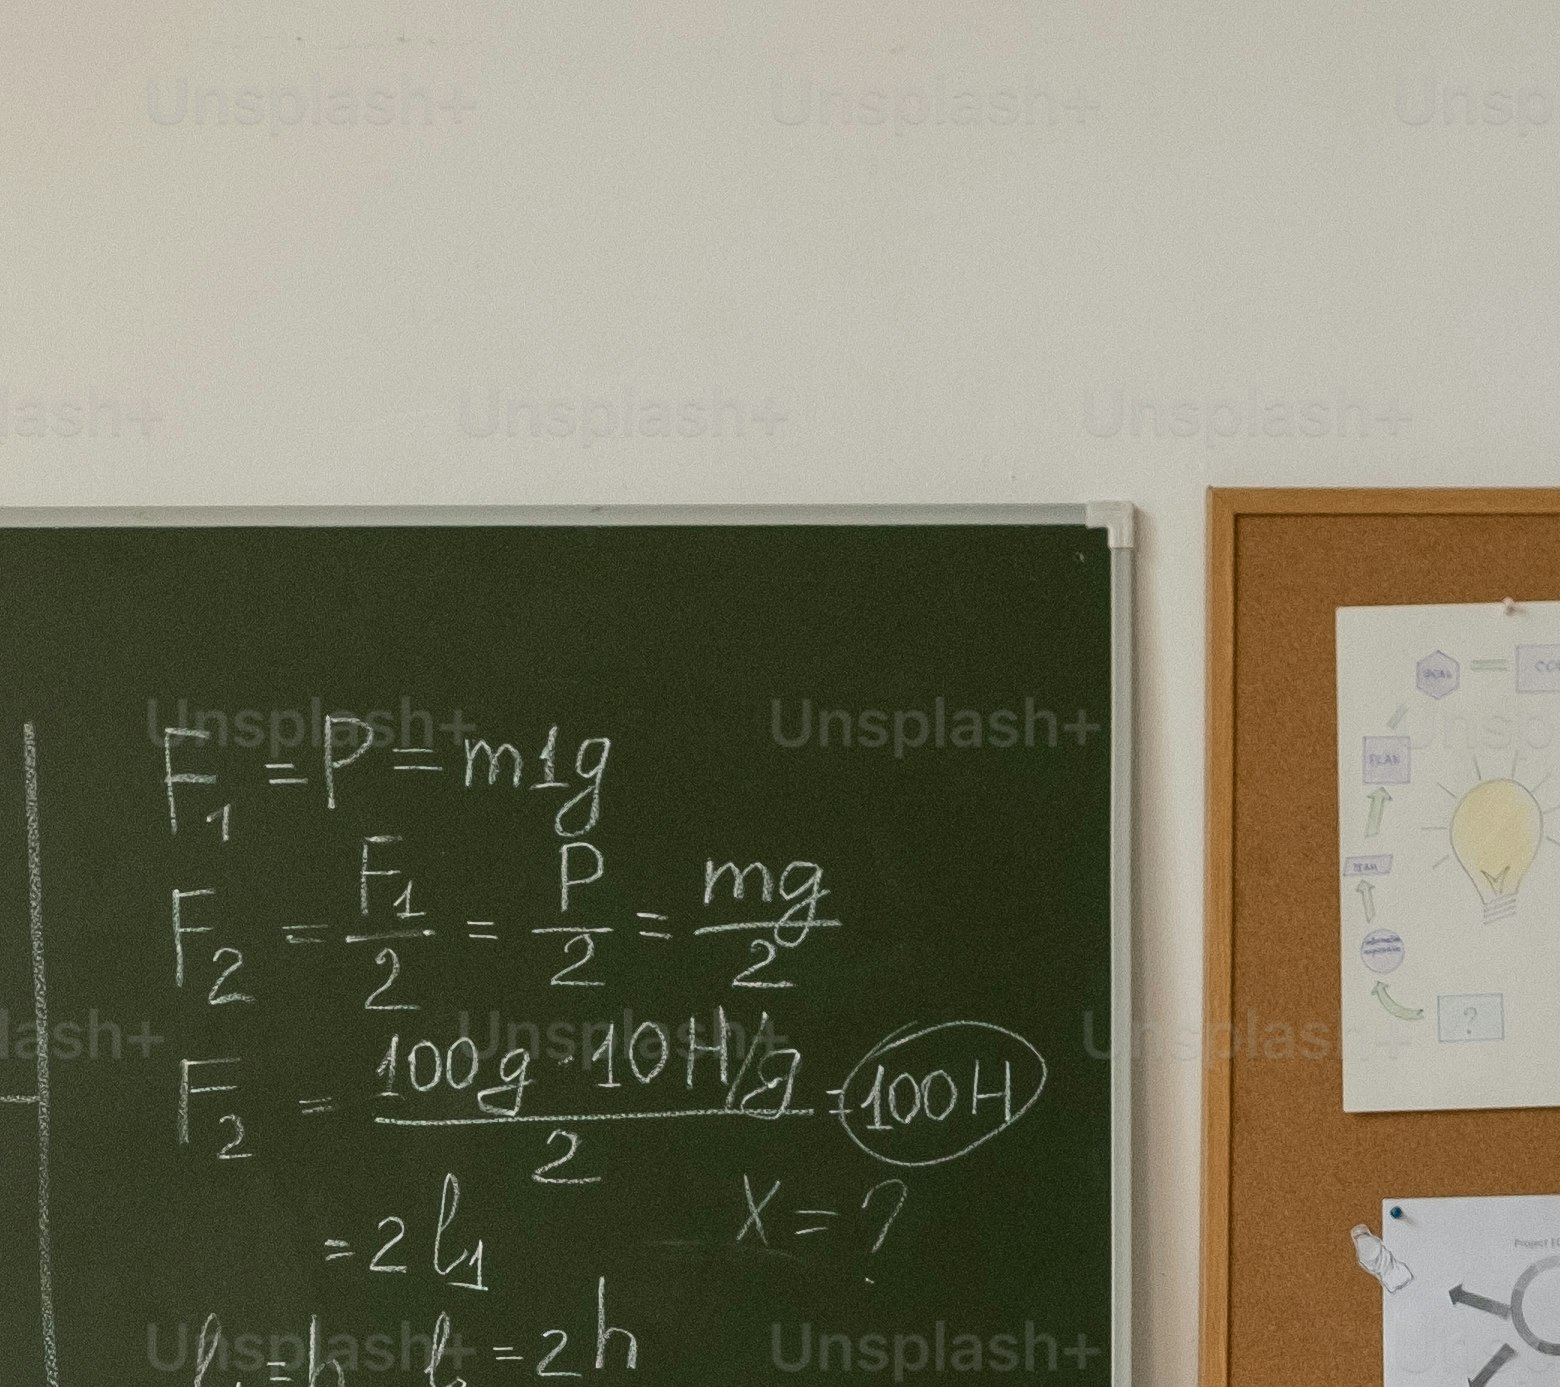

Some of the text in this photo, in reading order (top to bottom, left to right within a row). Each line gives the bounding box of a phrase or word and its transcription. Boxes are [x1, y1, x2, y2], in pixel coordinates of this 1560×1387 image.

[323, 713, 374, 810] P
[559, 841, 605, 912] P
[364, 946, 421, 1012] 2
[549, 933, 607, 988] 2
[731, 939, 797, 990] 2
[532, 1128, 603, 1185] 2
